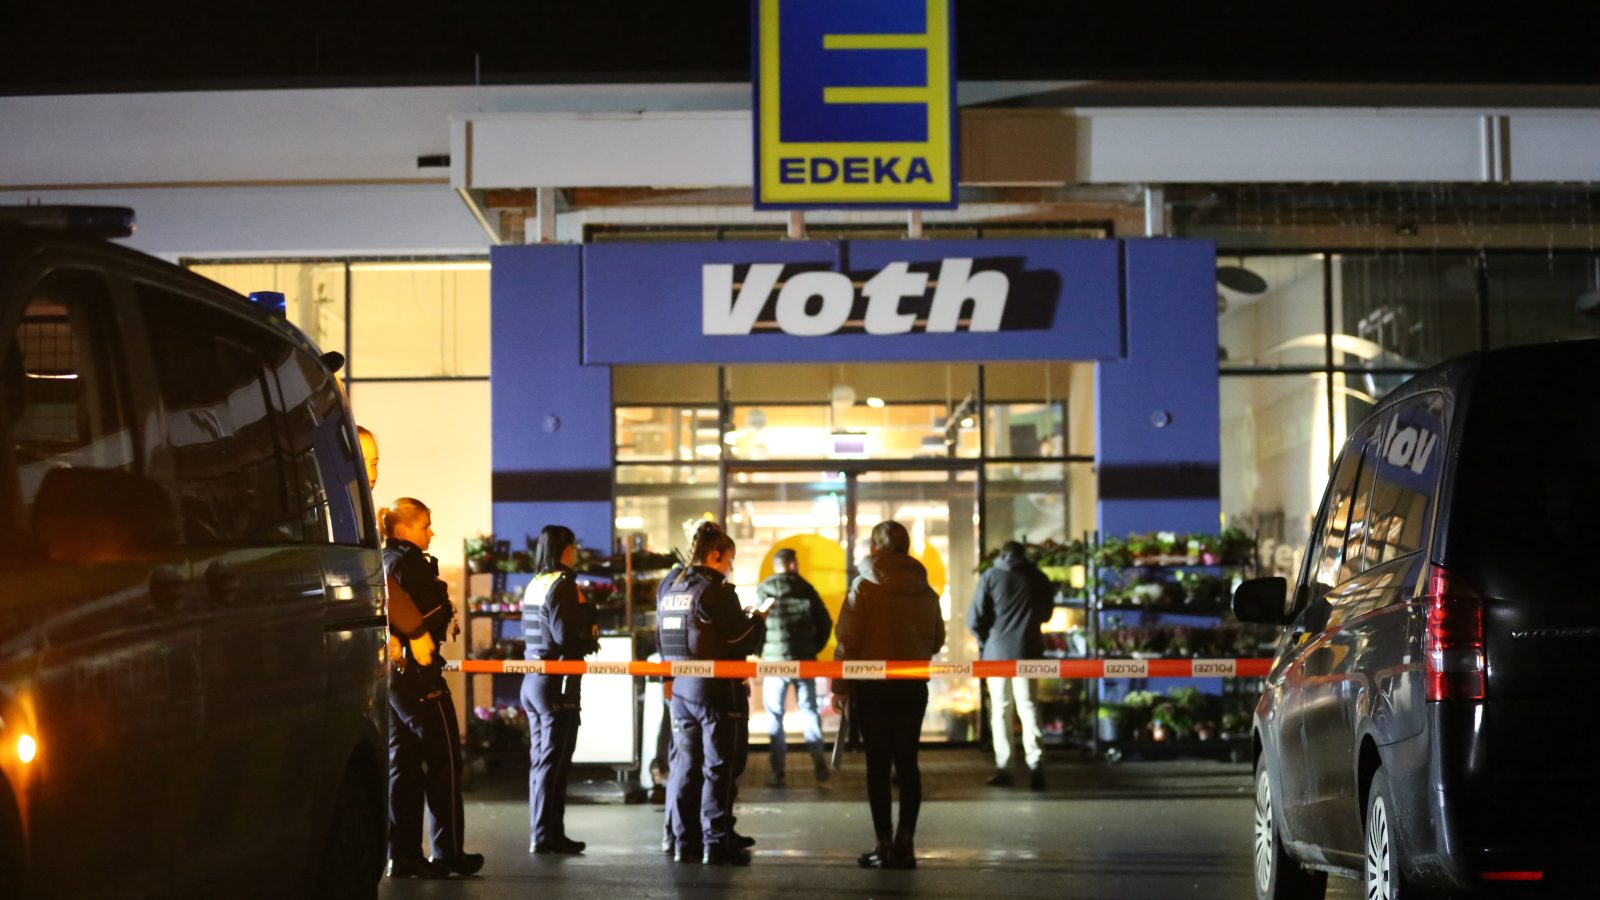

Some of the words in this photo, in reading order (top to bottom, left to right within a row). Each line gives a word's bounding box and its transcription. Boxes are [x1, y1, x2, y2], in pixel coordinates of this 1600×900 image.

[779, 157, 934, 184] EDEKA
[702, 257, 1010, 337] Voth
[660, 594, 693, 611] POLIZEI
[505, 665, 542, 674] POLIZEI
[589, 666, 626, 674] POLIZEI
[673, 665, 711, 674] POLIZEI
[759, 665, 797, 674] POLIZEI
[845, 665, 883, 674] POLIZEI
[931, 665, 970, 674] POLIZEI
[1019, 664, 1057, 673] POLIZEI
[1106, 664, 1145, 673] POLIZEI
[1194, 664, 1233, 673] POLIZEI
